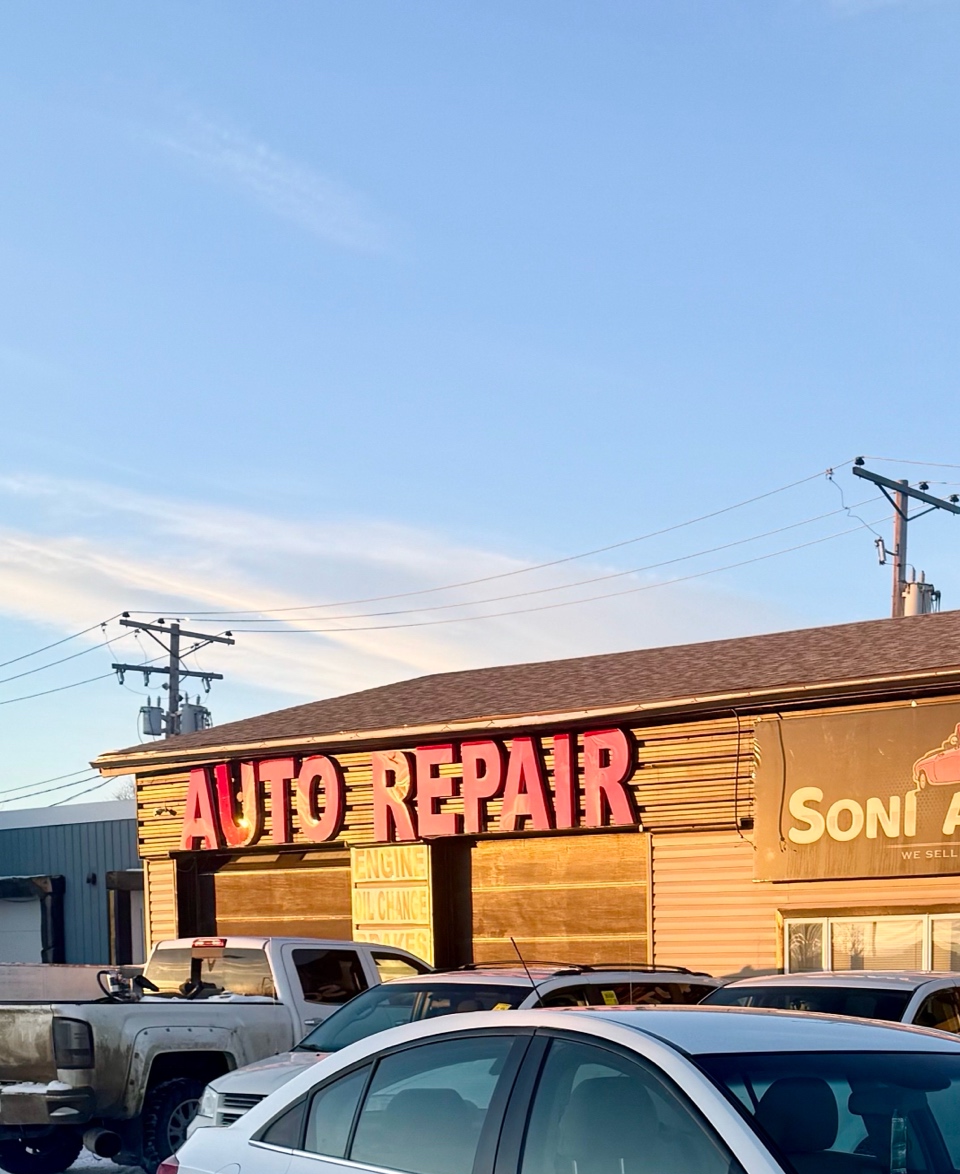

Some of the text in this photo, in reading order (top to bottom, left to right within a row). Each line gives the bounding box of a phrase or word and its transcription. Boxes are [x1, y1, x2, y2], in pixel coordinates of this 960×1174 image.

[178, 728, 636, 850] AUTO REPAIR
[788, 786, 918, 845] SONI
[354, 849, 426, 879] ENGINE
[901, 850, 921, 860] WE
[925, 849, 958, 859] SELL
[354, 890, 427, 921] OIL CHANGE
